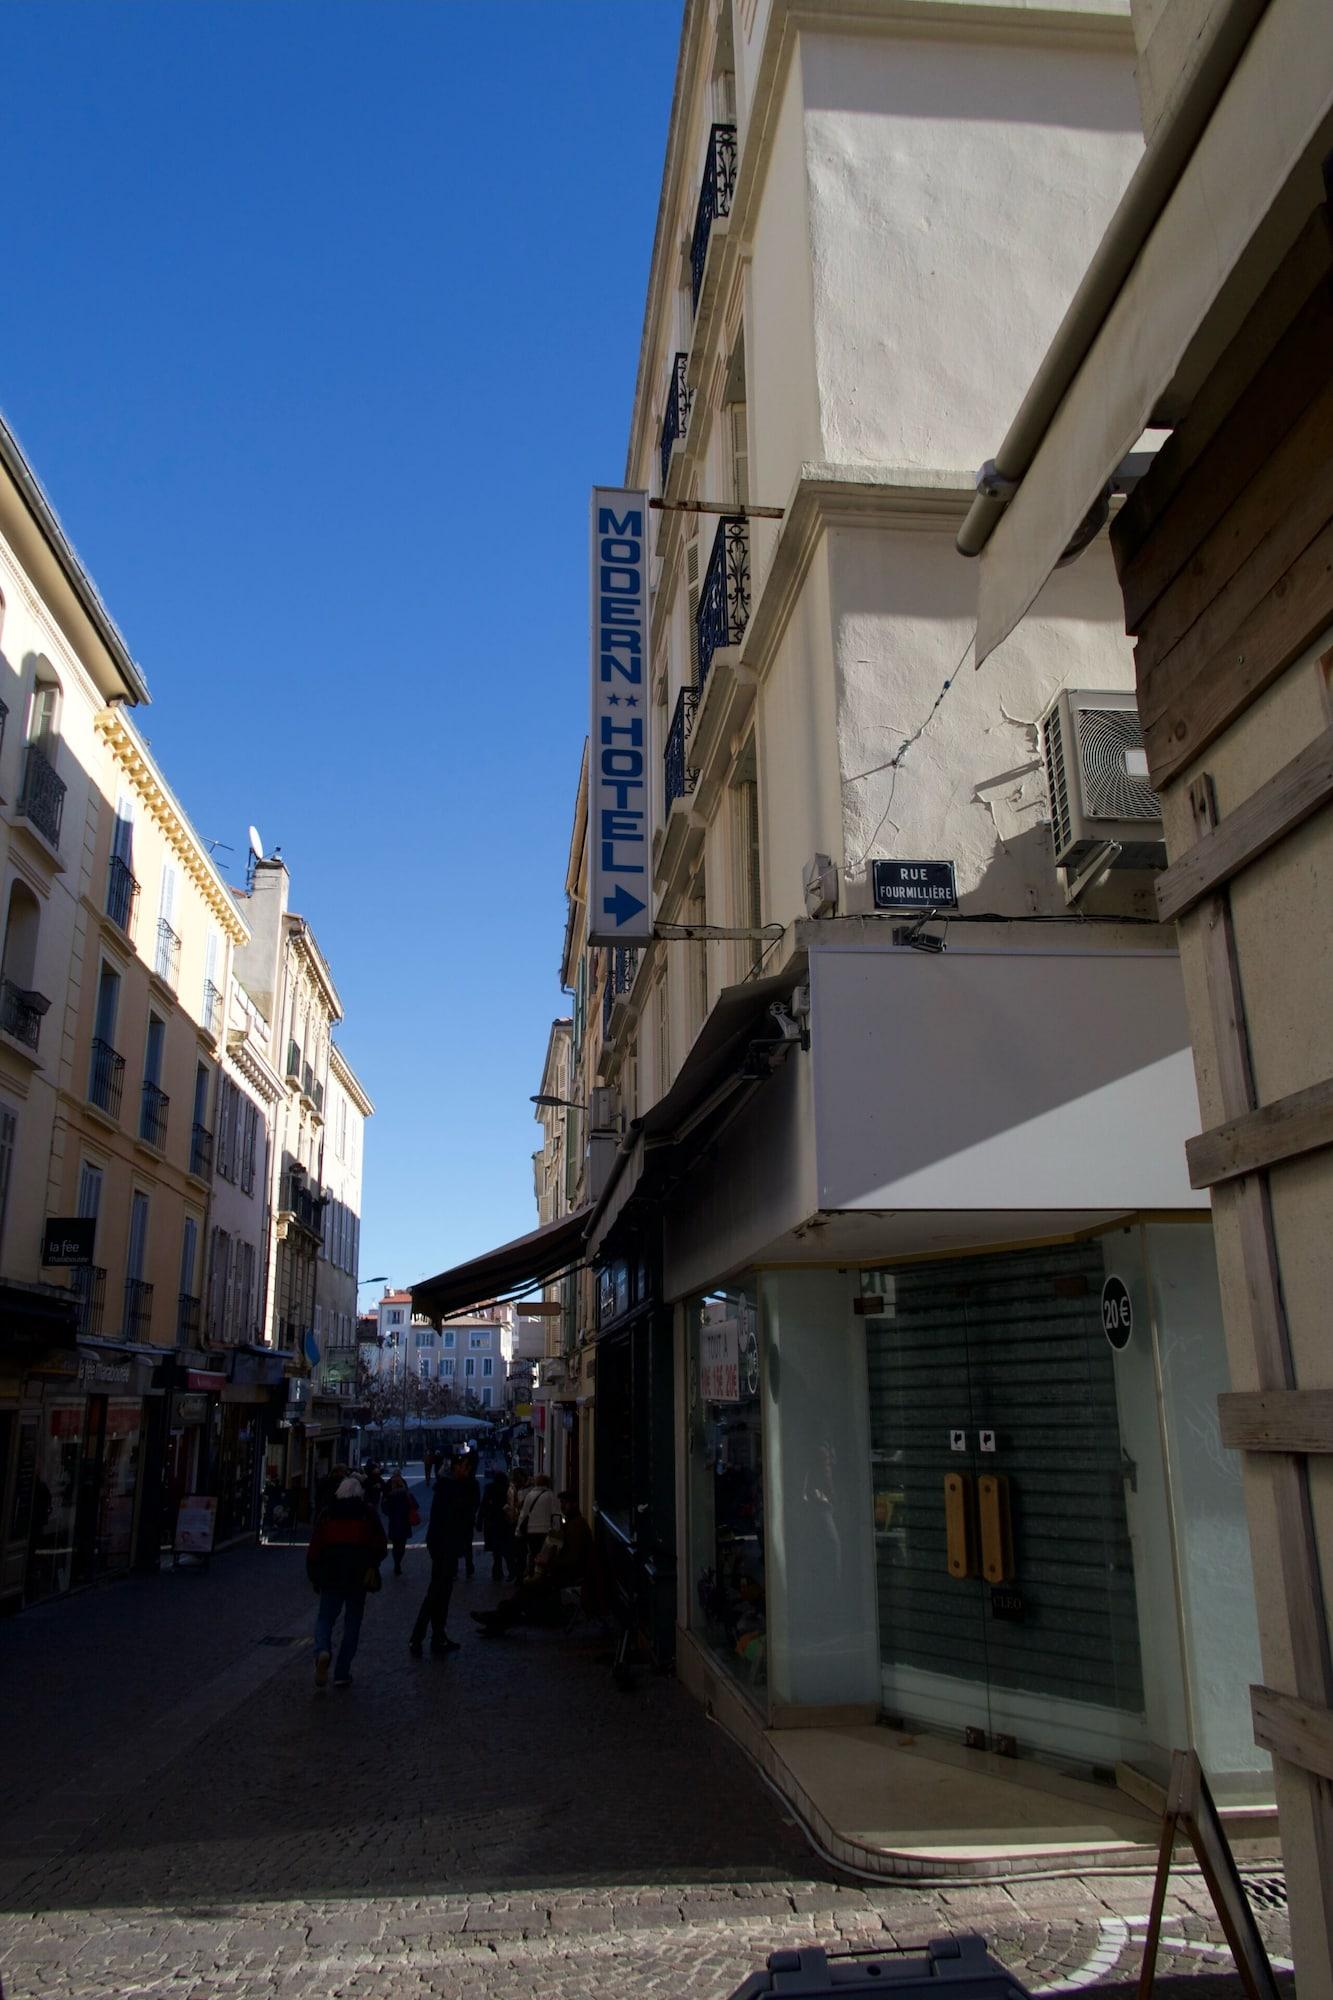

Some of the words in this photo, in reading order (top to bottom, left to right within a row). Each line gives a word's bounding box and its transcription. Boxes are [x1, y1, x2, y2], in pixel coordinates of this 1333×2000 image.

[600, 507, 642, 684] MODERN
[601, 716, 644, 874] HOTEL
[900, 868, 928, 880] RUE
[880, 885, 952, 899] FOURMILLIÈRE
[49, 1241, 60, 1253] la
